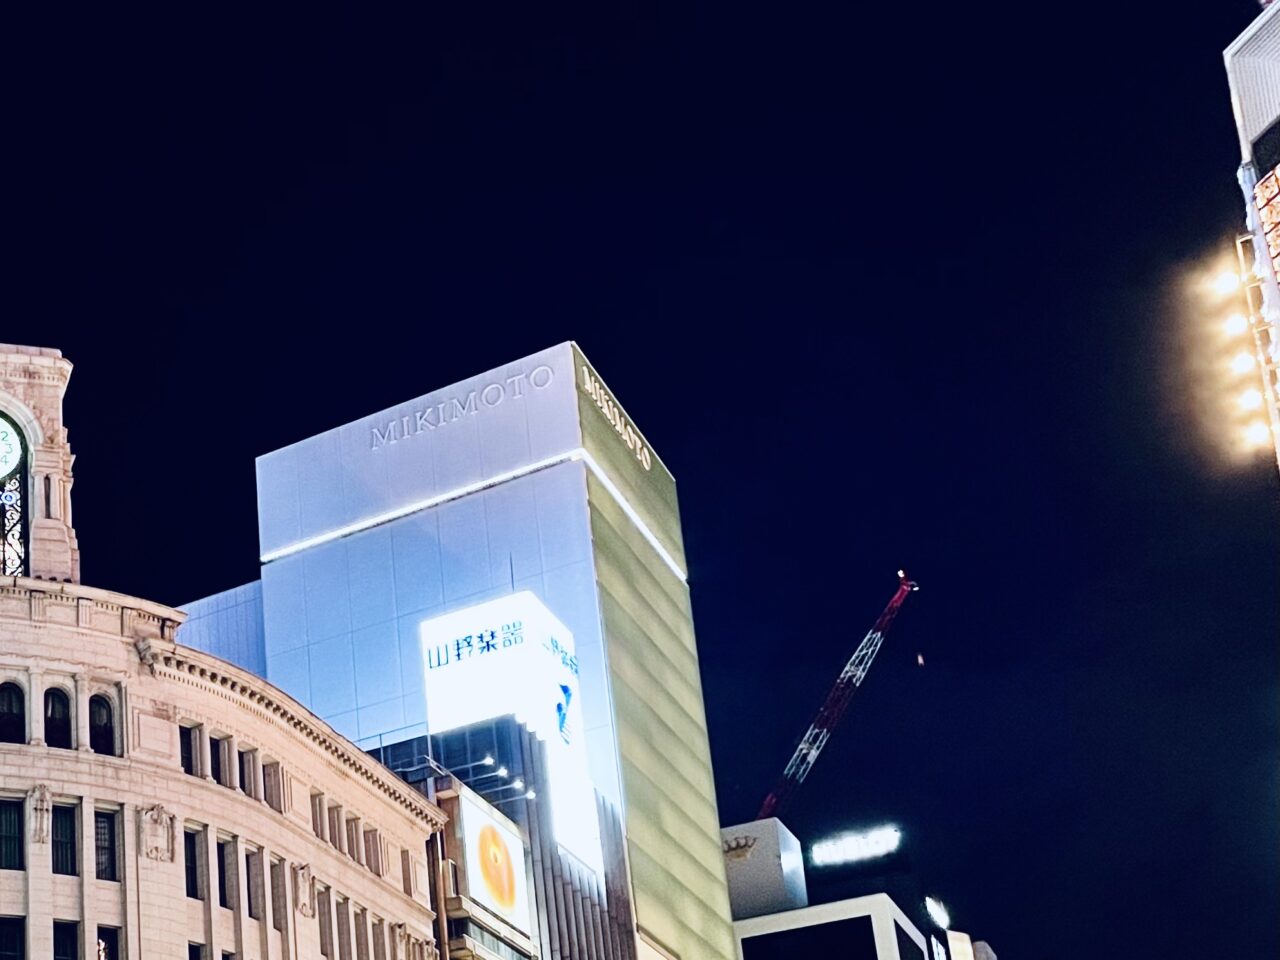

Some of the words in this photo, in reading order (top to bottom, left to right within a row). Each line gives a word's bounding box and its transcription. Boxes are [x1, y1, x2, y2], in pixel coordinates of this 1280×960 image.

[371, 365, 555, 450] MIKIMOTO
[582, 366, 652, 471] MIKIMOTO
[0, 430, 9, 442] 2
[5, 443, 13, 454] 3
[0, 455, 9, 465] 4
